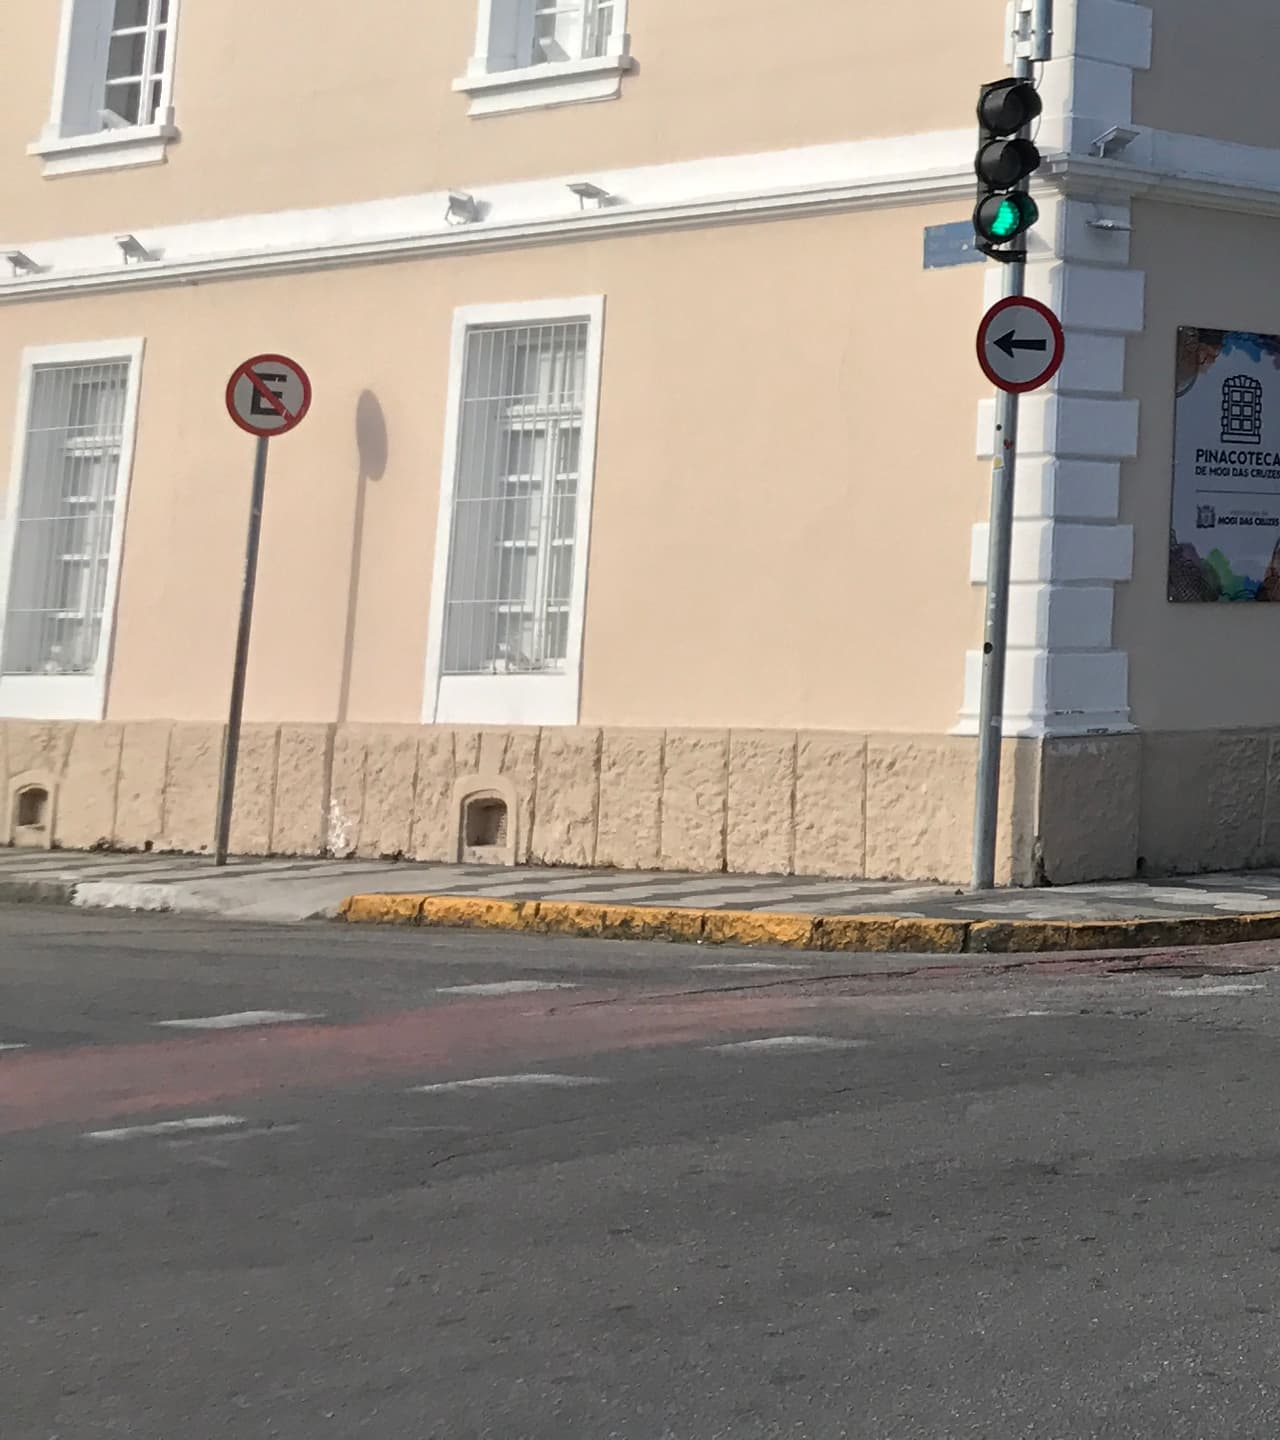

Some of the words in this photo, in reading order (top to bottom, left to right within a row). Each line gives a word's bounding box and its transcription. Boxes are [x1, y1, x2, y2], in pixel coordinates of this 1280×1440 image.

[251, 373, 288, 416] E
[1195, 448, 1280, 467] PINACOTECA
[1195, 466, 1207, 476] DE
[1209, 467, 1230, 477] MOGI
[1232, 468, 1249, 477] DAS
[1250, 469, 1280, 479] CRUZES
